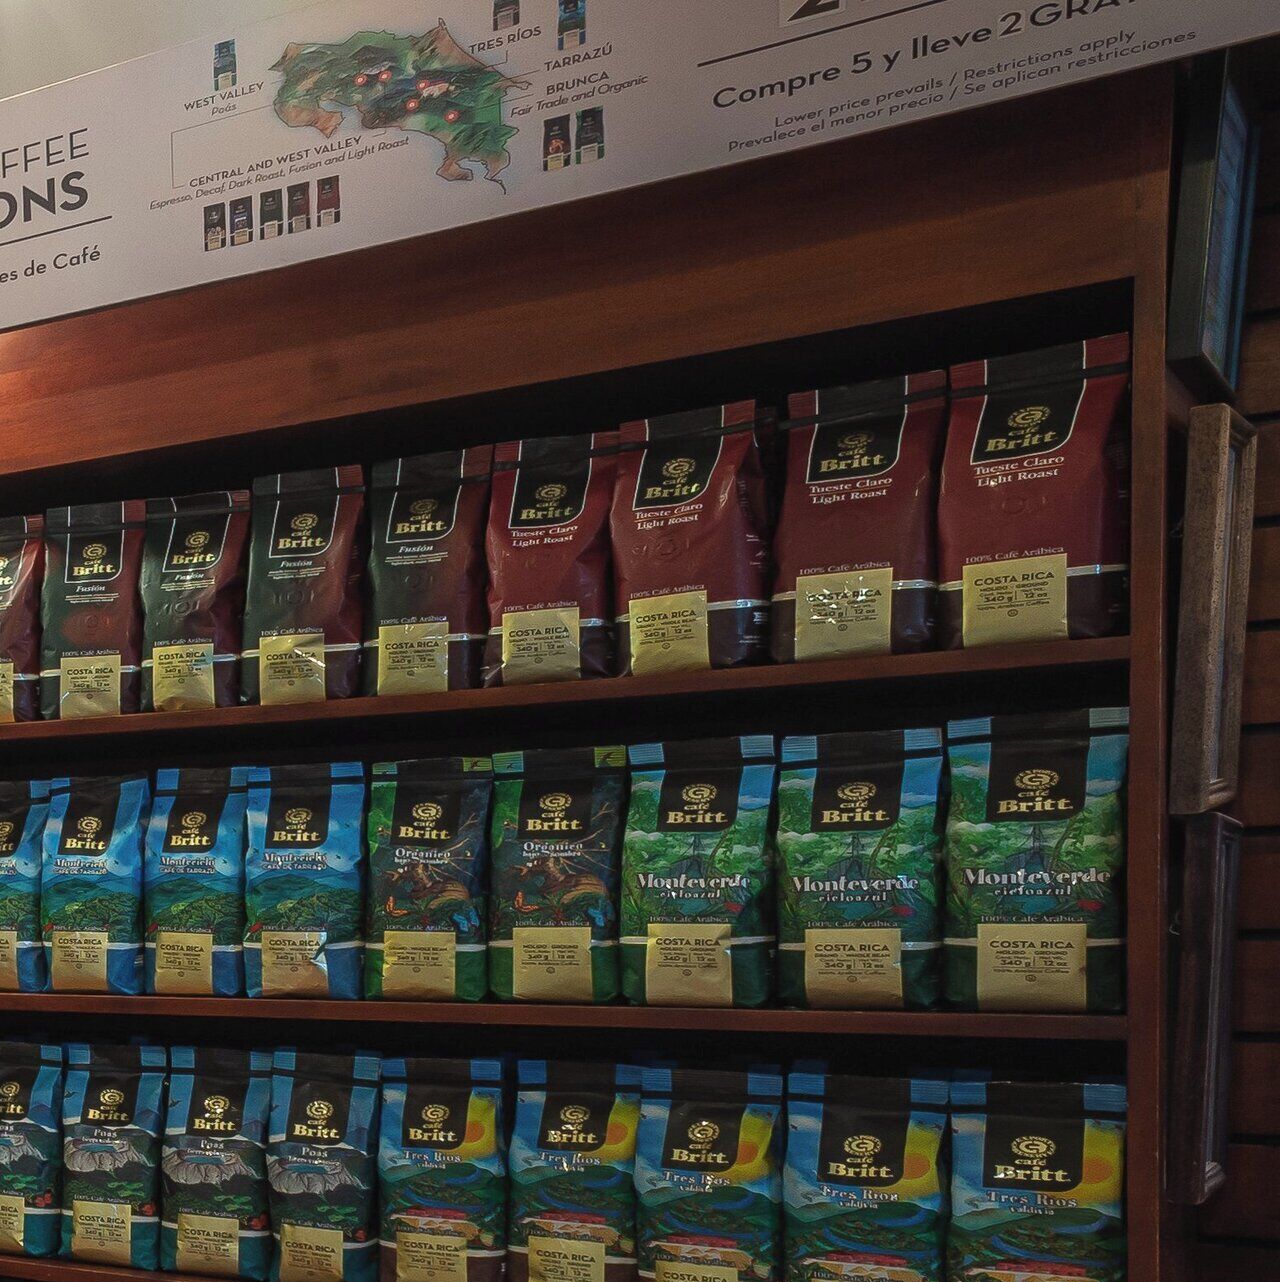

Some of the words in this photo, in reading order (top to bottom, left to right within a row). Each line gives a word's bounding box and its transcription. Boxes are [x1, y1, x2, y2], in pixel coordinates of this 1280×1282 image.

[470, 37, 505, 56] TRES
[508, 26, 542, 47] RÍOS
[544, 42, 613, 73] TARRAZÚ
[712, 65, 840, 109] Compre
[851, 50, 873, 75] 5
[883, 50, 901, 72] y
[912, 23, 993, 61] lleve
[999, 12, 1022, 37] 2
[547, 70, 609, 95] BRUNCA
[728, 127, 805, 152] Prevalece
[811, 119, 826, 134] el
[830, 107, 883, 130] menor
[889, 93, 943, 117] precio
[964, 80, 985, 94] Se
[992, 64, 1061, 92] aplican
[1067, 30, 1196, 71] restricciones
[775, 107, 823, 128] Lower
[829, 99, 870, 121] price
[876, 79, 943, 109] prevails
[964, 46, 1073, 81] Restrictions
[1079, 30, 1136, 55] apply
[184, 92, 217, 111] WEST
[219, 81, 264, 102] VALLEY
[511, 103, 533, 118] Fair
[535, 94, 564, 113] Trade
[567, 89, 594, 106] and
[598, 73, 649, 101] Organic
[211, 102, 237, 117] Poás
[189, 166, 243, 188] CENTRAL
[247, 158, 272, 175] AND
[276, 148, 310, 168] WEST
[314, 136, 361, 158] VALLEY
[228, 175, 252, 191] Dark
[288, 160, 322, 178] Fusion
[325, 154, 345, 169] and
[348, 145, 375, 166] Light
[378, 136, 409, 155] Roast
[23, 259, 47, 281] de
[53, 245, 101, 273] Café
[985, 429, 1058, 452] Britt
[1024, 455, 1065, 468] Claro
[977, 475, 1012, 487] Light
[1018, 468, 1059, 480] Roast
[974, 575, 1017, 586] COSTA
[1022, 571, 1054, 582] RICA
[998, 799, 1073, 814] Britt
[963, 868, 1110, 885] Monteverde
[990, 940, 1036, 949] COSTA
[1041, 940, 1074, 949] RICA
[987, 1191, 1029, 1204] Tres
